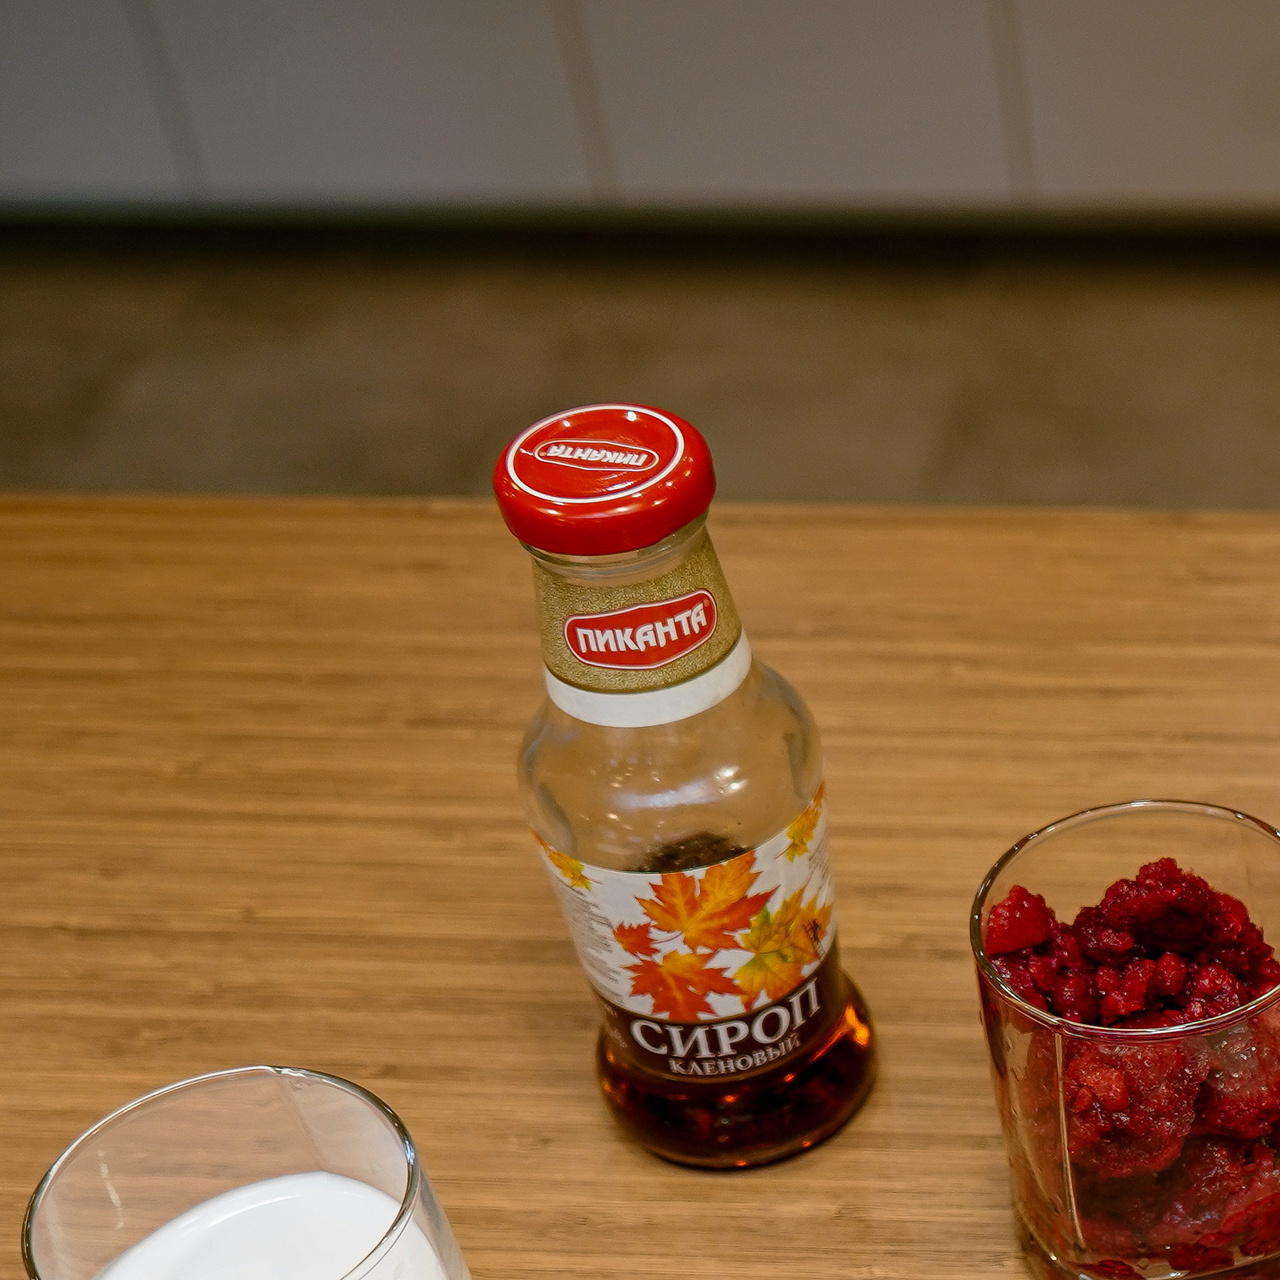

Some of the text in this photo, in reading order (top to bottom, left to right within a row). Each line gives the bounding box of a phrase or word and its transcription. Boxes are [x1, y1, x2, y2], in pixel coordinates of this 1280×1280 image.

[547, 444, 649, 467] ПИКАНТА
[575, 603, 708, 654] ПИКАНТА
[630, 977, 822, 1059] СИРОП
[668, 1031, 801, 1076] КЛЕНОВЫЙ
